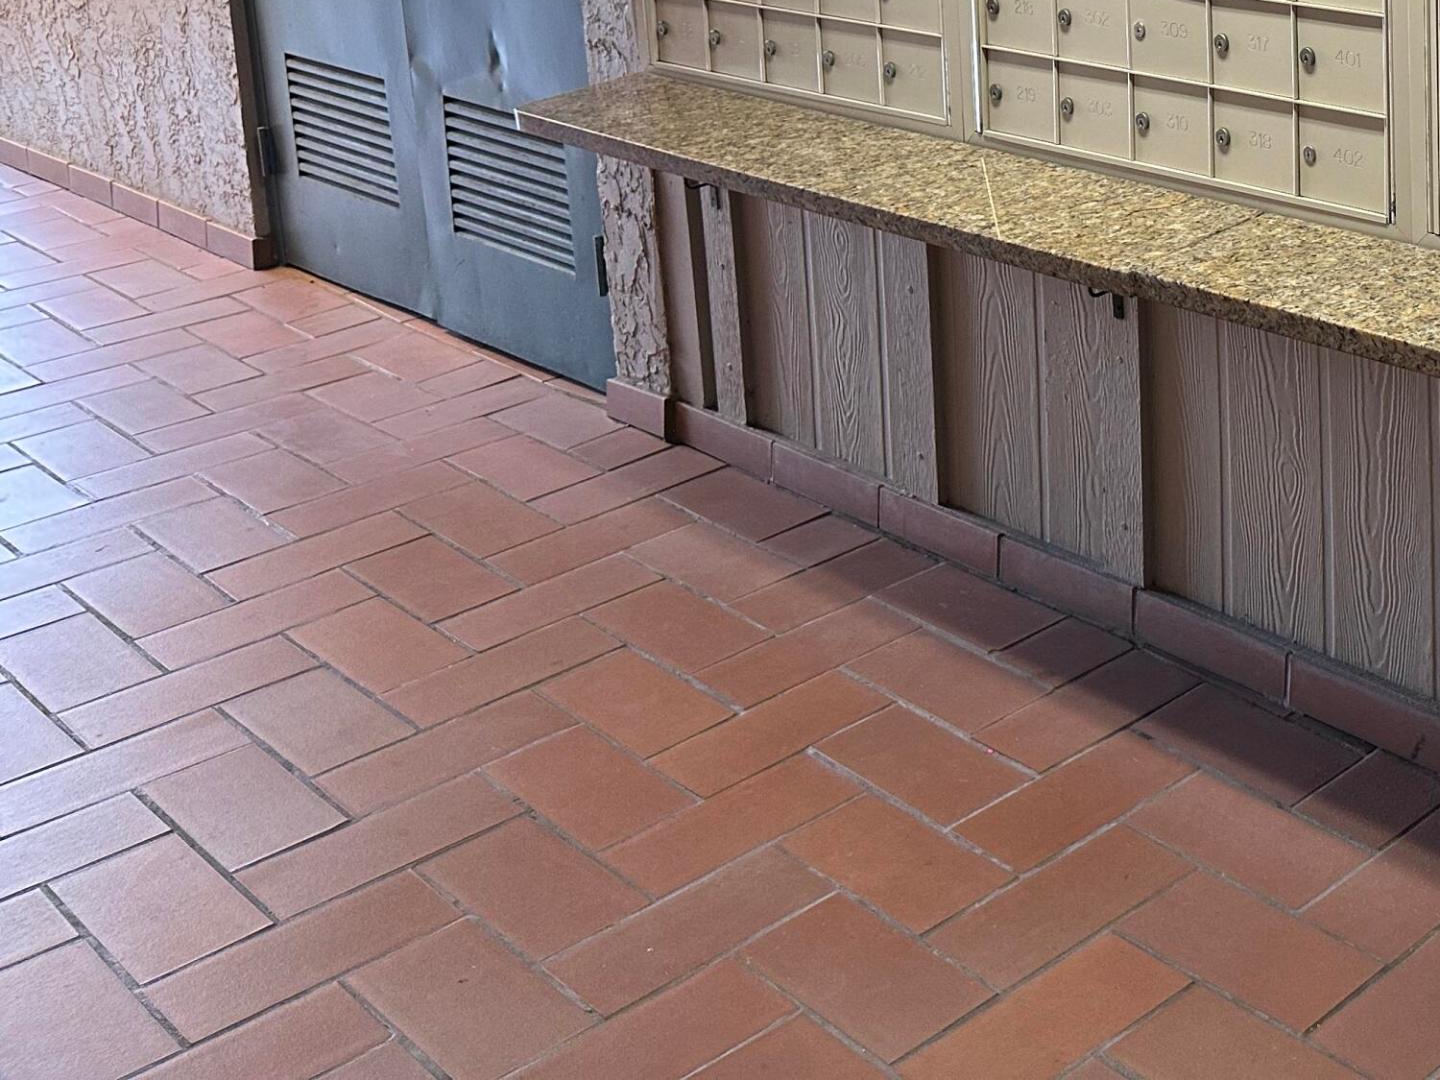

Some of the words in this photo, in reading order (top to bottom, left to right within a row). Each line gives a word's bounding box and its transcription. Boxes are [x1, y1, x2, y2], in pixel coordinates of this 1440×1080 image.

[1160, 20, 1189, 40] 309
[1247, 33, 1271, 52] 317
[1334, 49, 1362, 69] 401
[1016, 86, 1037, 103] 219
[1248, 130, 1273, 150] 318
[1333, 147, 1364, 168] 402
